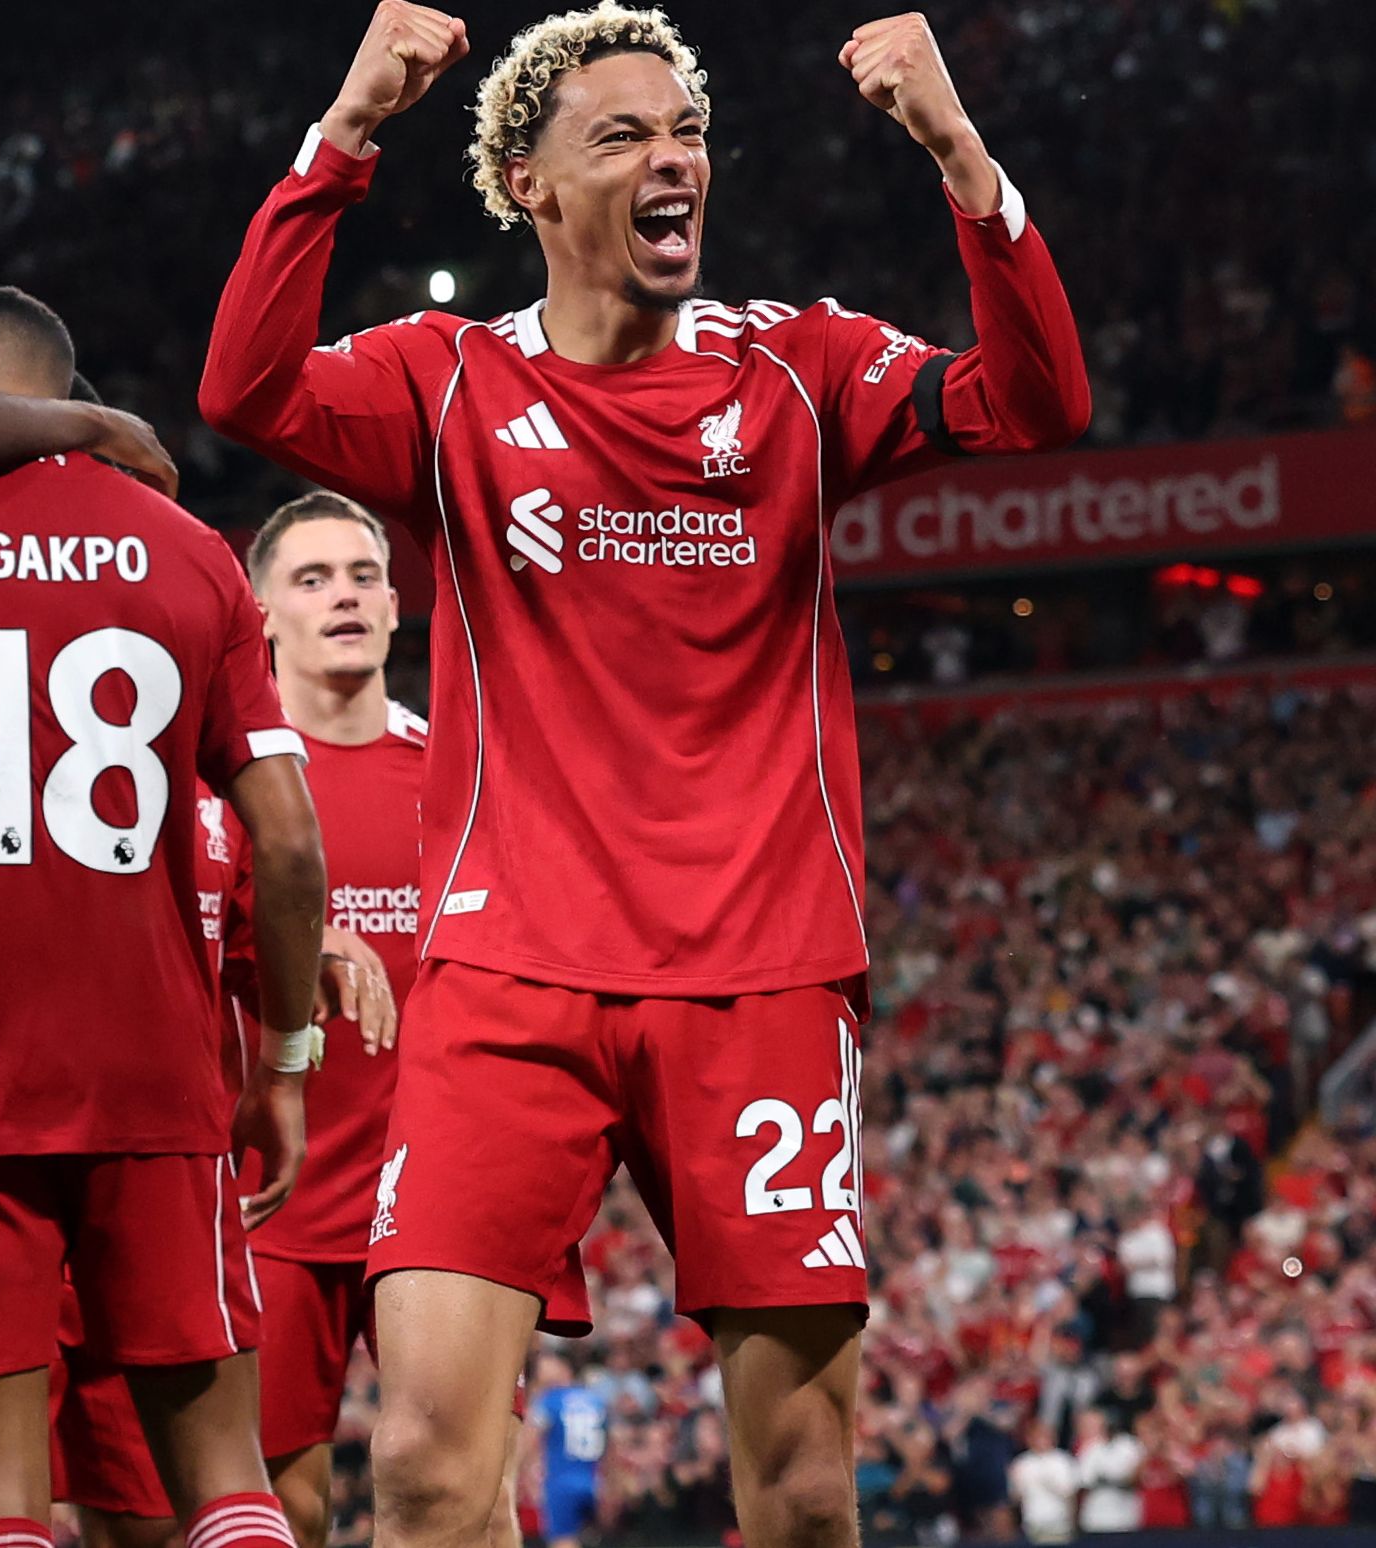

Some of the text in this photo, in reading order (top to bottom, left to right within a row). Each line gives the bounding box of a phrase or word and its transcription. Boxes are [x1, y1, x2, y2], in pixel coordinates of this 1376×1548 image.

[702, 456, 751, 479] L.F.C.
[577, 503, 745, 537] standard
[894, 454, 1281, 557] chartered
[577, 532, 757, 567] chartered
[734, 1097, 857, 1217] 22
